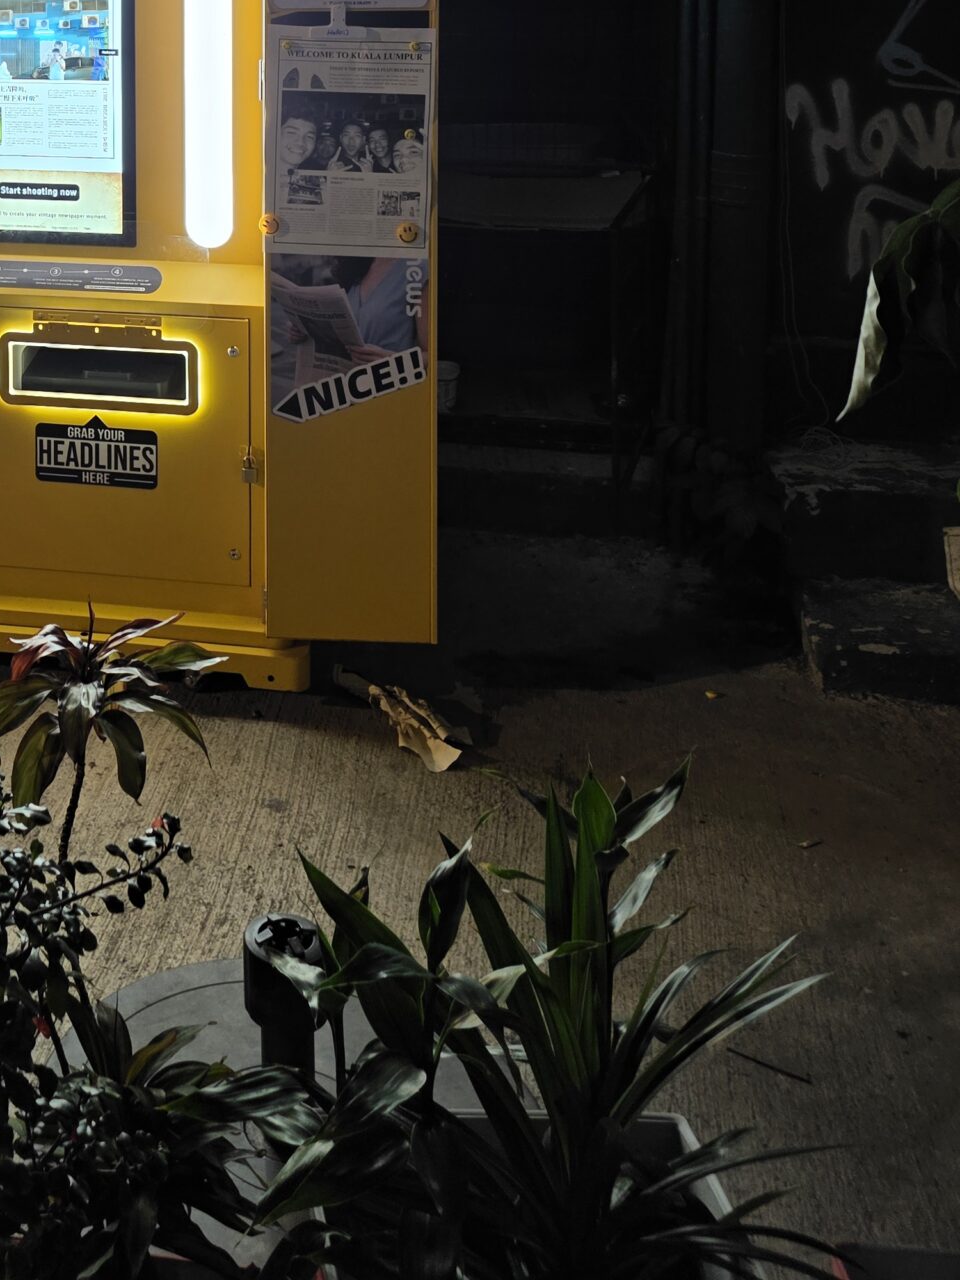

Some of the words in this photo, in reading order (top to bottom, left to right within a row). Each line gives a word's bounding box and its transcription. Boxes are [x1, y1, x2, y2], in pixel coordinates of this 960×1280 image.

[287, 49, 334, 59] WELCOME
[337, 50, 349, 59] TO
[351, 50, 382, 60] KUALA
[384, 51, 424, 61] LUMPUR
[0, 186, 22, 195] Start
[22, 187, 58, 198] shooting
[60, 188, 77, 197] now
[304, 350, 425, 416] NICE!!
[67, 426, 95, 439] GRAB
[98, 428, 125, 441] YOUR
[39, 439, 155, 473] HEADLINES
[82, 471, 110, 484] HERE
